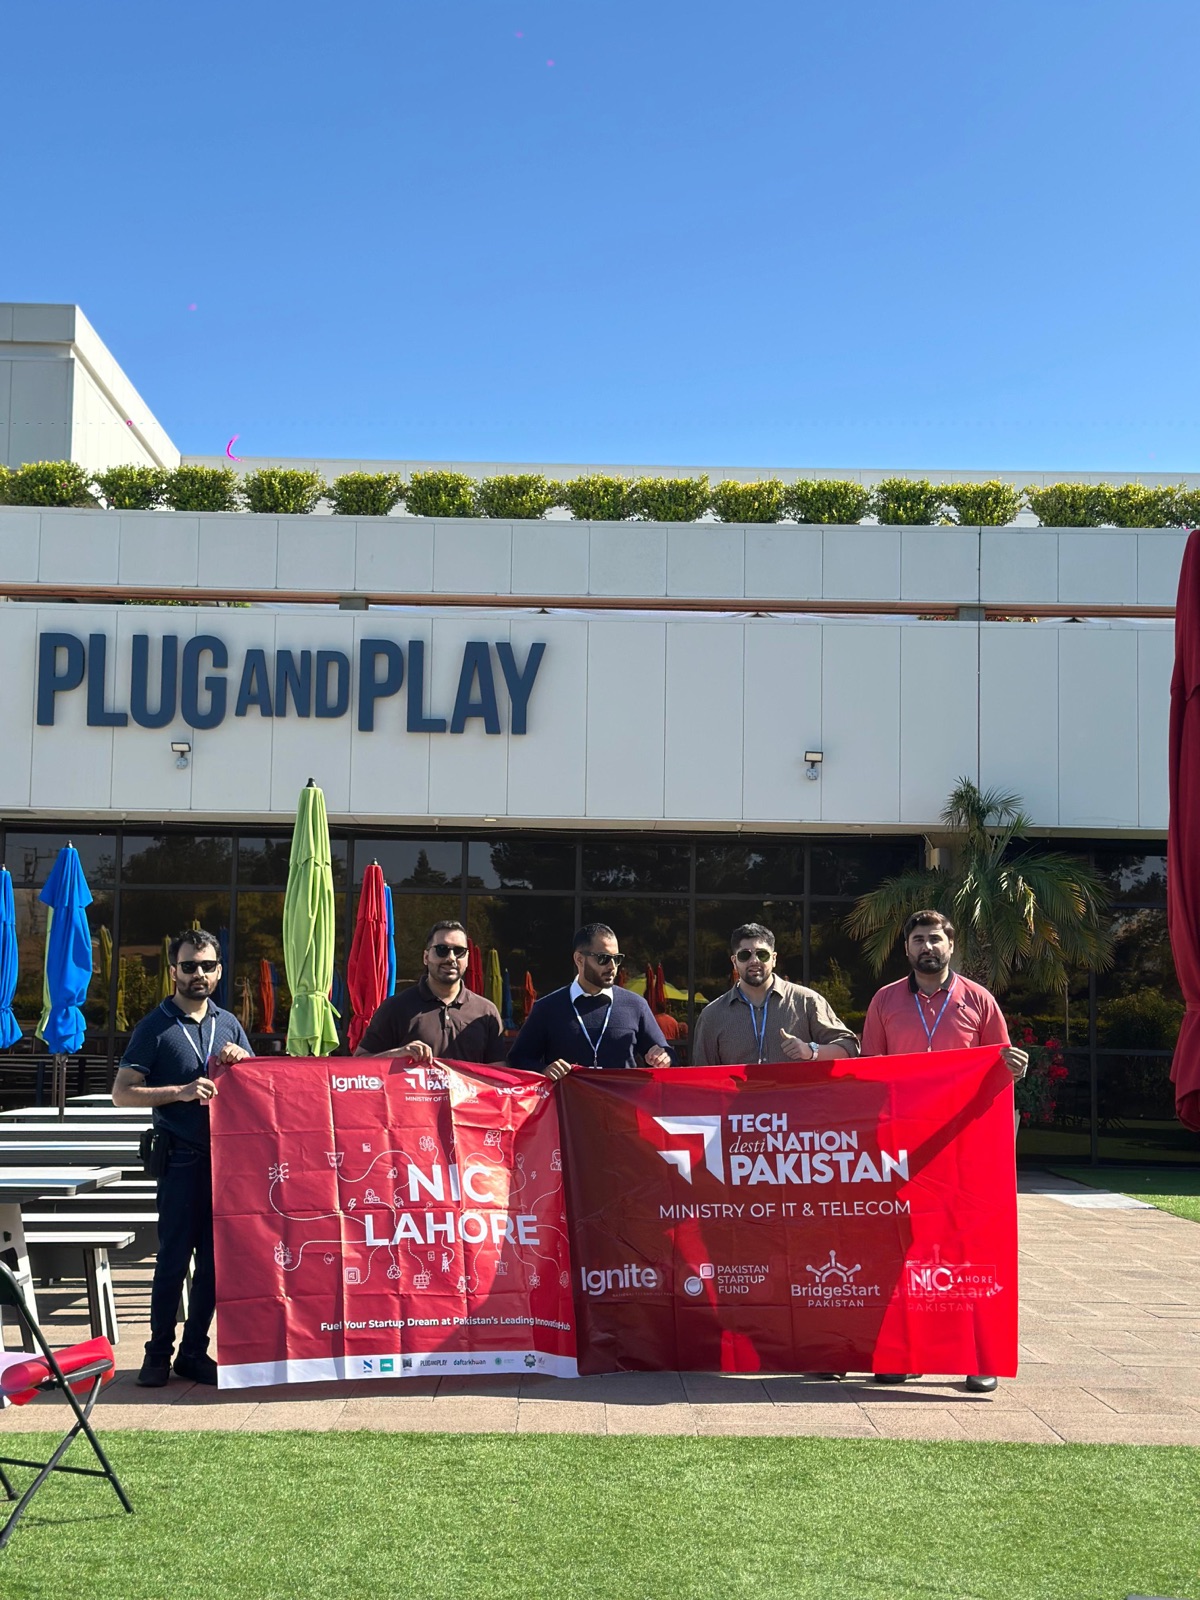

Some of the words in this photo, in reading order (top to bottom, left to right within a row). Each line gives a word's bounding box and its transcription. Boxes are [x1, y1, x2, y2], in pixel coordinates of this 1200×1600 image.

[331, 1074, 380, 1092] Ignite
[728, 1112, 788, 1133] TECH
[730, 1149, 910, 1185] PAKISTAN
[407, 1163, 495, 1203] NIC
[659, 1203, 745, 1219] MINISTRY
[750, 1203, 776, 1218] OF
[782, 1203, 797, 1217] IT
[802, 1202, 815, 1217] &
[818, 1200, 911, 1217] TELECOM
[364, 1211, 541, 1247] LAHORE
[717, 1264, 769, 1274] PAKISTAN
[580, 1263, 658, 1296] Ignite
[717, 1274, 766, 1284] STARTUP
[910, 1267, 953, 1292] NIC
[949, 1275, 993, 1284] LAHORE
[718, 1285, 749, 1295] FUND
[790, 1283, 881, 1299] BridgeStart
[808, 1299, 865, 1308] PAKISTAN
[320, 1321, 342, 1331] Fuel
[344, 1320, 366, 1329] Your
[368, 1319, 405, 1329] Startup
[407, 1318, 439, 1327] Dream
[441, 1317, 451, 1325] at
[453, 1315, 499, 1326] Pakistan's
[500, 1315, 535, 1326] Leading
[558, 1321, 571, 1331] Hub
